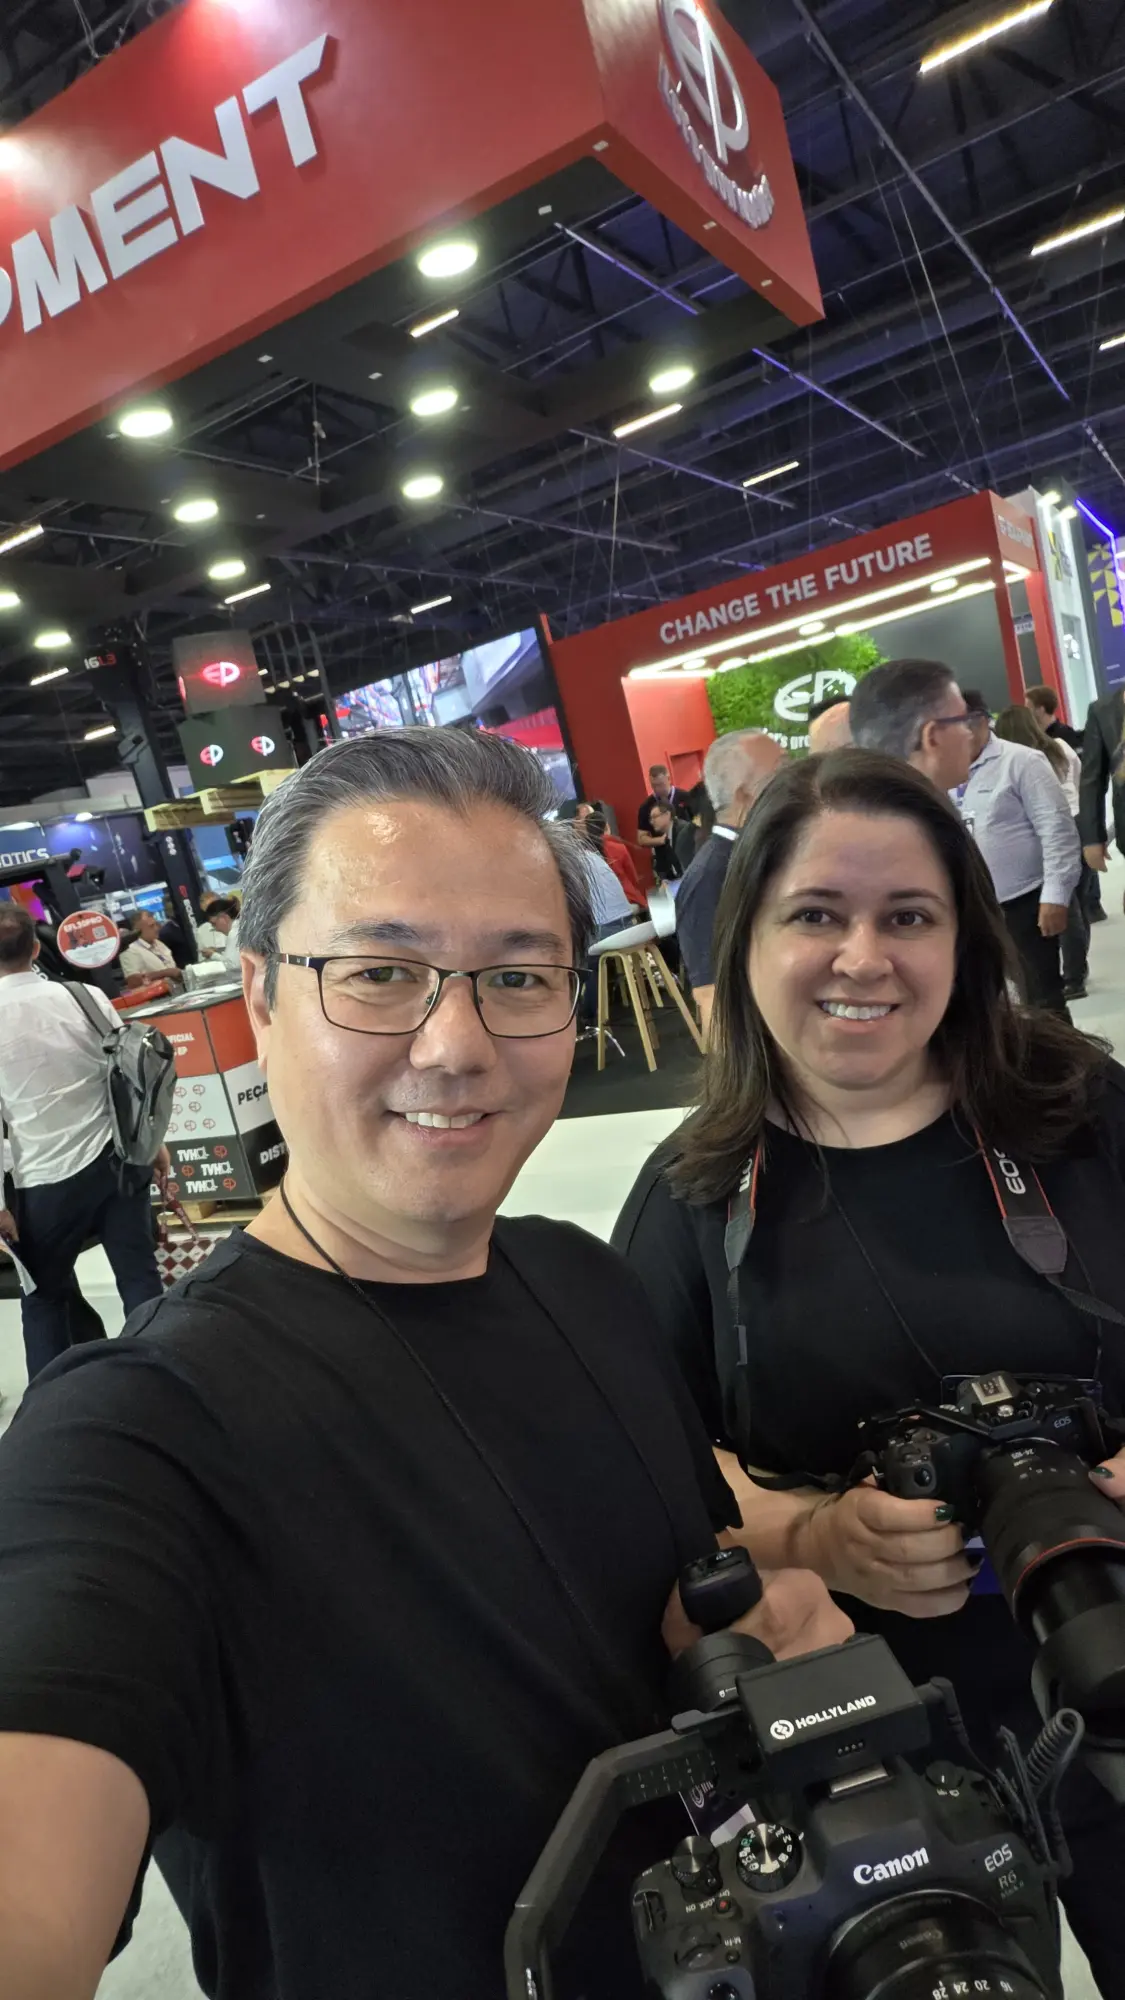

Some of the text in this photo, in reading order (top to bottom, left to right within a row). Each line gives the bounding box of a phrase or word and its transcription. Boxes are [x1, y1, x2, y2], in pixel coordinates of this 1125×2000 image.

[660, 532, 934, 645] CHANGE THE FUTURE
[0, 847, 50, 868] OTICS
[795, 1695, 877, 1729] HOLLYLAND
[853, 1847, 930, 1885] Canon
[984, 1843, 1013, 1873] EOS
[998, 1870, 1018, 1890] R6
[953, 1981, 970, 1995] 24
[974, 1980, 990, 1991] 20
[1000, 1981, 1014, 1993] 16
